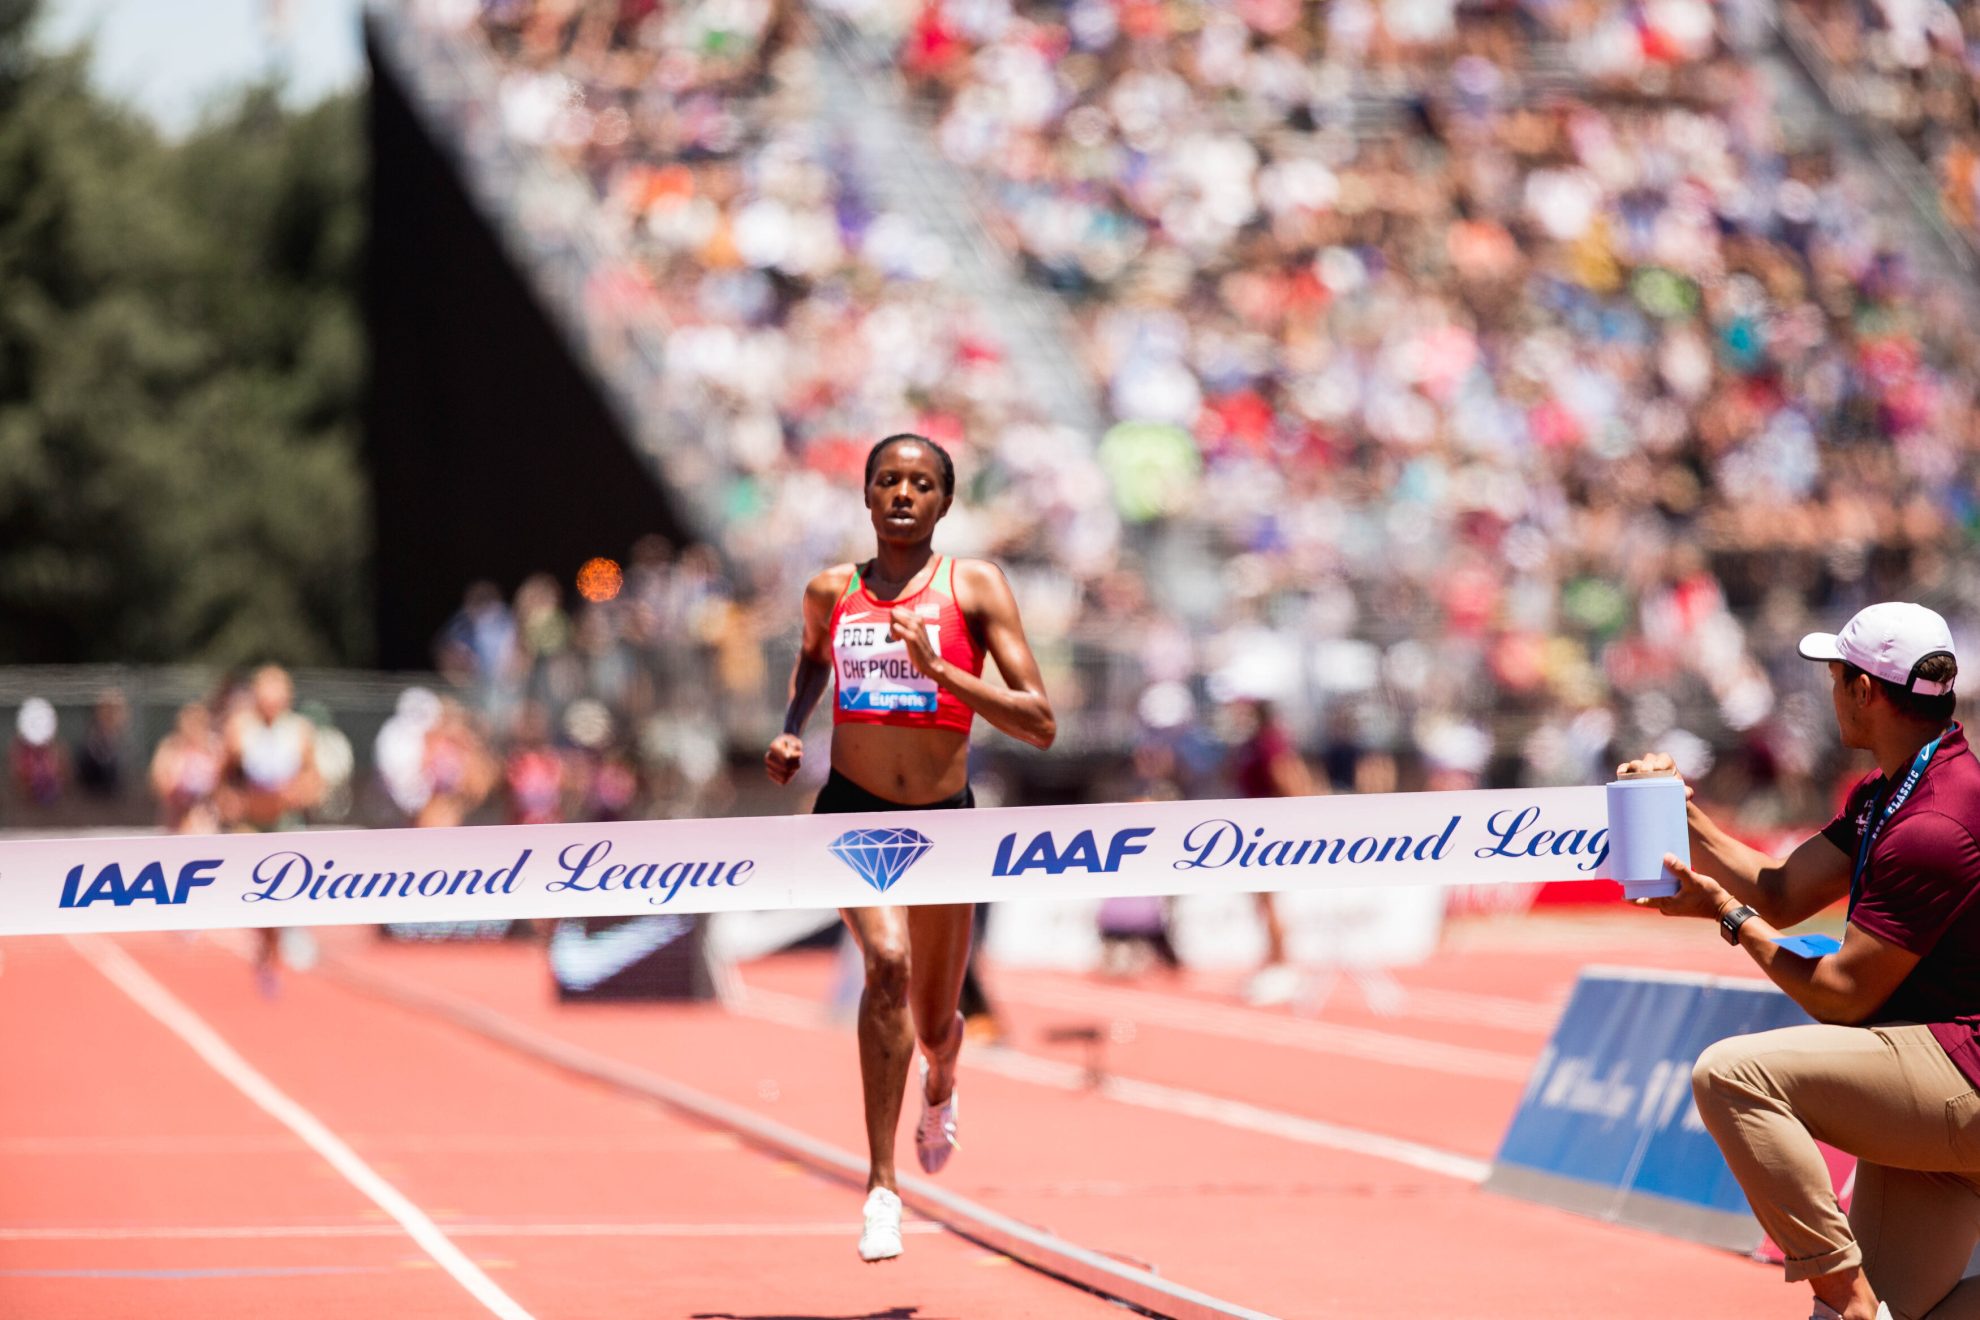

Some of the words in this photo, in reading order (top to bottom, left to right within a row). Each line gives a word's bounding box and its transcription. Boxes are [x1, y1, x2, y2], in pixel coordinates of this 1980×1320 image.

[841, 628, 874, 647] PRE
[842, 659, 926, 679] CHEPKOEC
[869, 691, 927, 709] Eugene
[1887, 769, 1919, 815] CLASSIC
[991, 827, 1156, 877] IAAF
[1173, 815, 1462, 871] Diamond
[59, 859, 225, 908] IAAF
[241, 849, 533, 903] Diamond
[545, 839, 756, 905] League
